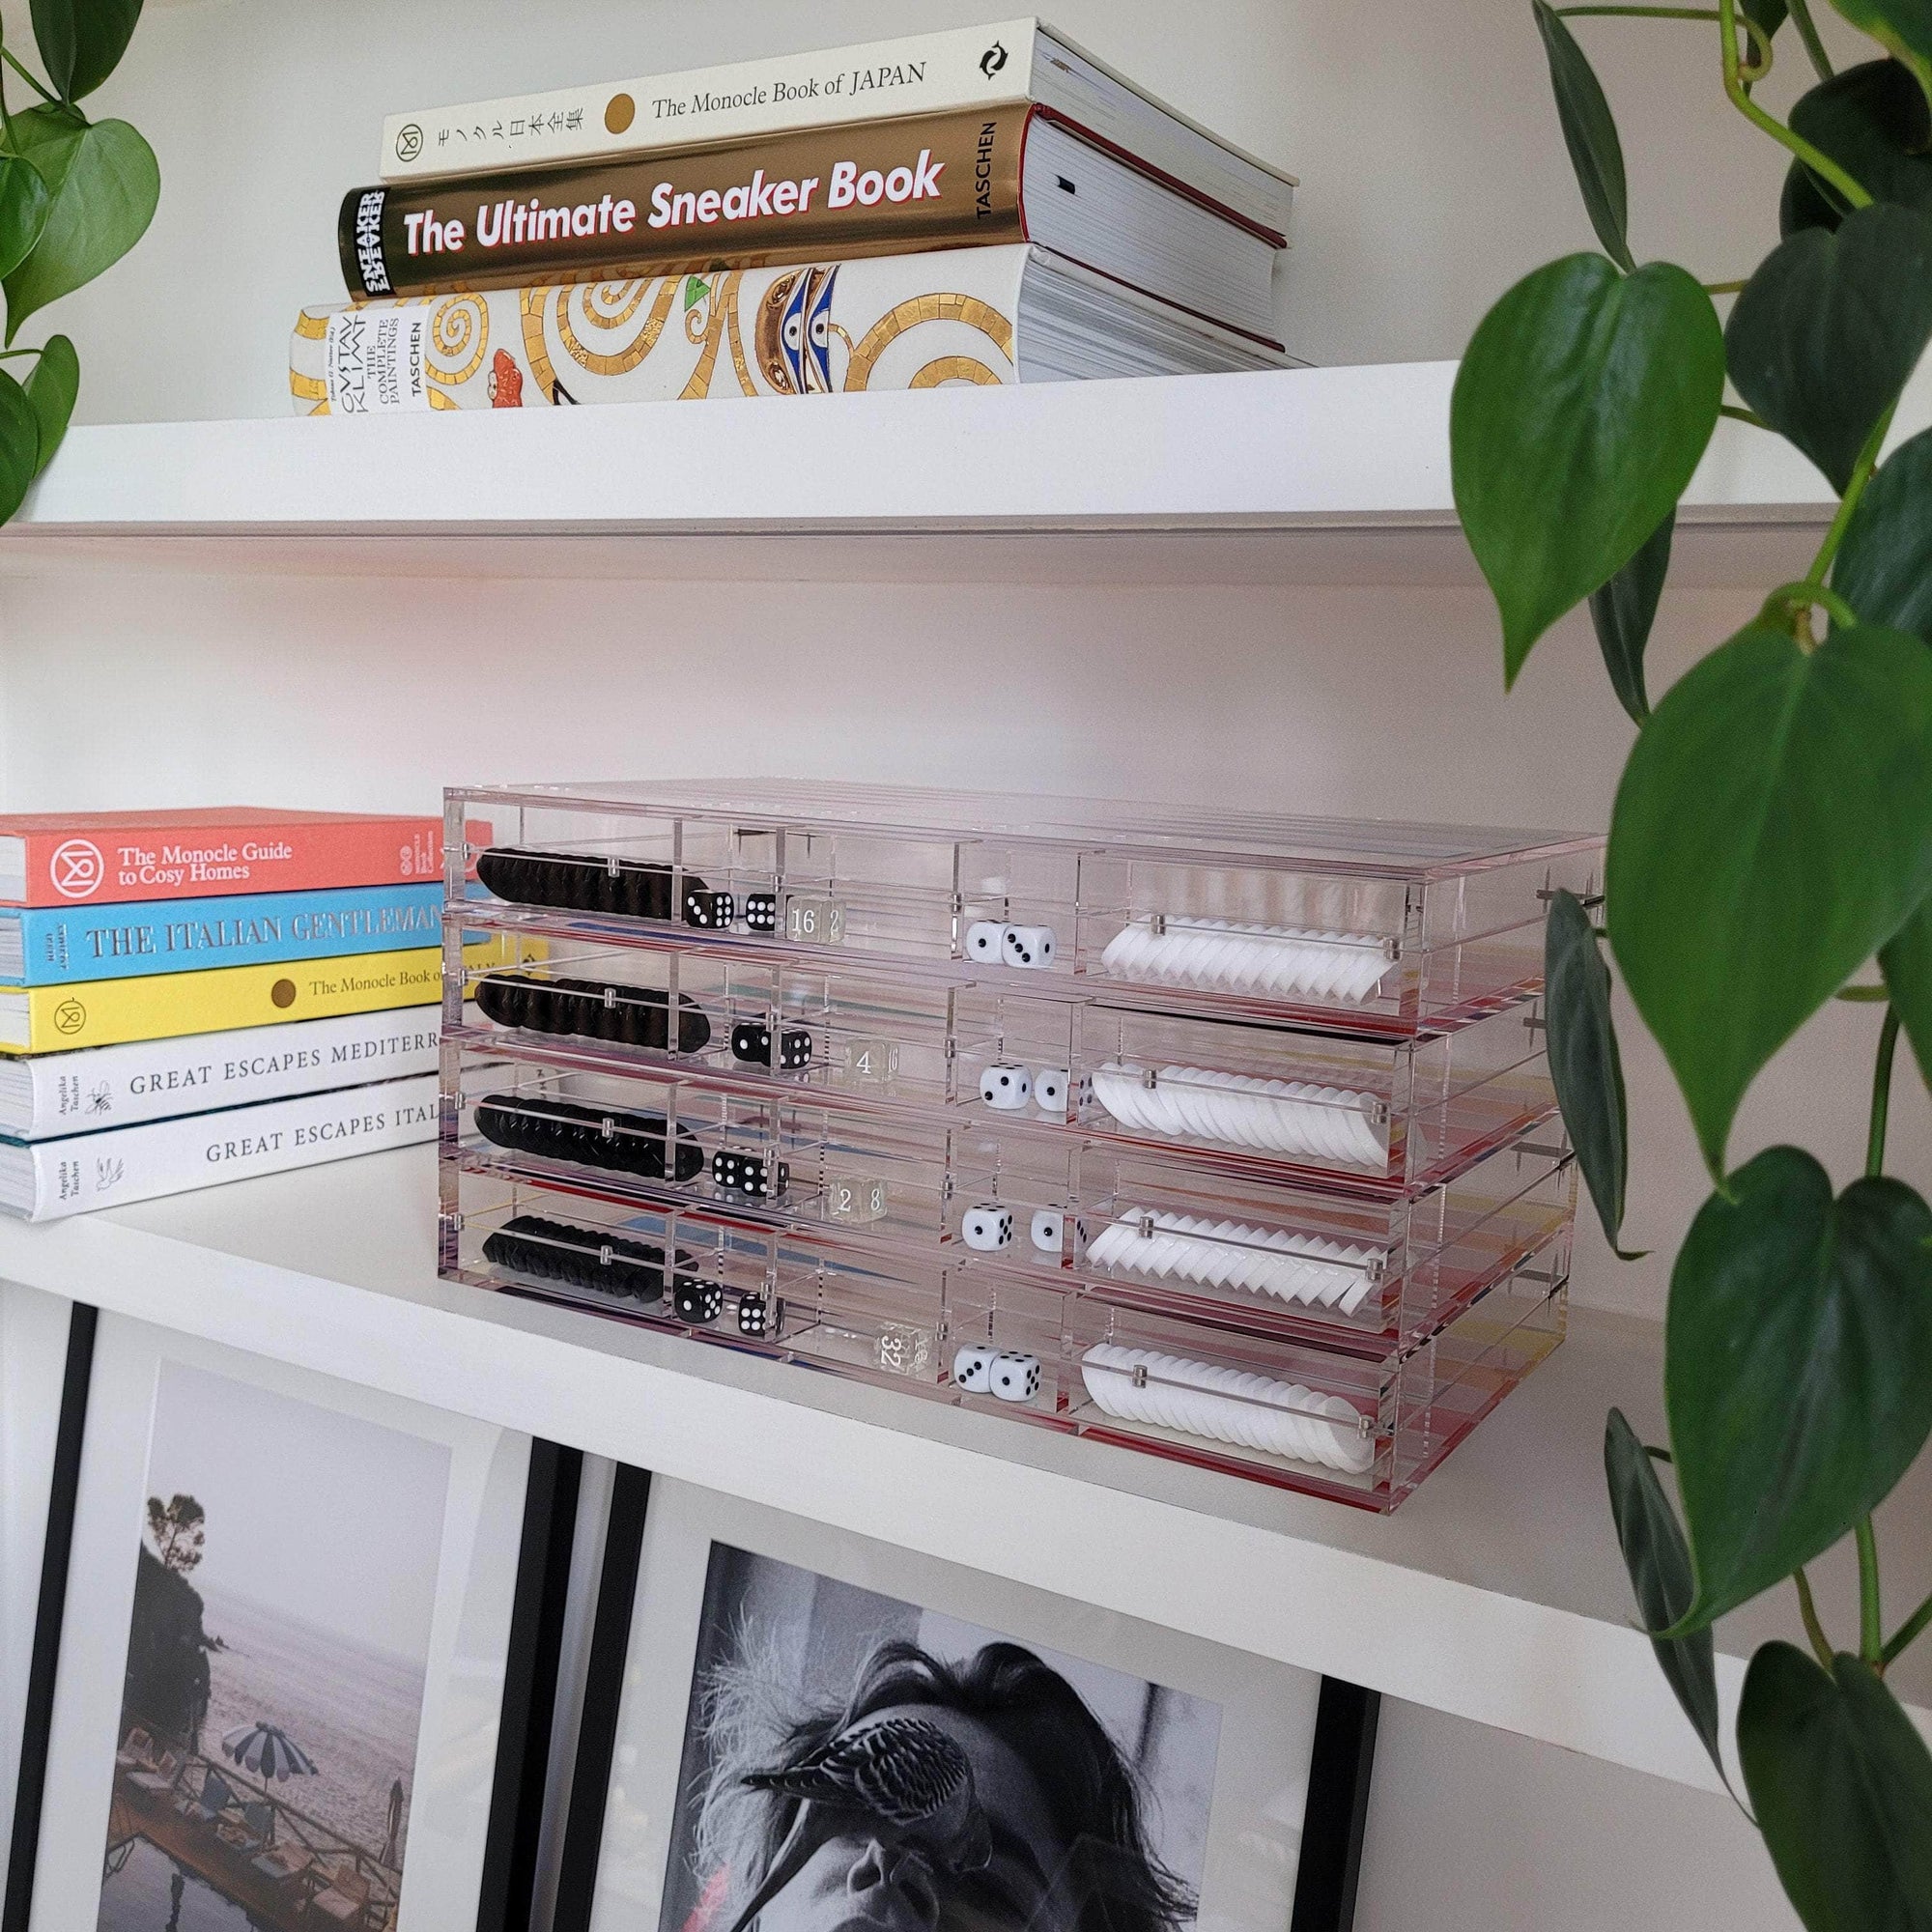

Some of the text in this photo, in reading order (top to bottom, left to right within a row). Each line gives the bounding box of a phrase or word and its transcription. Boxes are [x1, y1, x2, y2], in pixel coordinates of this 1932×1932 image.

[652, 61, 927, 119] The Monocle Book of JAPAN
[976, 122, 997, 219] TASCHEN
[403, 149, 947, 256] The Ultimate Sneaker Book
[356, 191, 378, 292] SNEAKER
[351, 315, 369, 412] KLIMT
[367, 345, 376, 379] THE
[377, 319, 389, 405] COMPLETE
[386, 318, 400, 404] PAINTINGS
[410, 323, 422, 397] TASCHEN
[117, 841, 293, 867] The Monocle Guide
[118, 863, 250, 887] to Cosy Homes
[86, 924, 156, 958] THE
[164, 916, 282, 952] ITALIAN
[792, 908, 814, 933] 16
[830, 909, 839, 933] 2
[309, 980, 337, 996] The
[340, 973, 395, 993] Monocle
[400, 969, 430, 985] Book
[129, 1065, 213, 1095] GREAT
[224, 1048, 322, 1081] ESCAPES
[856, 1050, 871, 1074] 4
[59, 1075, 70, 1116] Angelika
[71, 1075, 79, 1112] Taschen
[206, 1132, 283, 1163] GREAT
[295, 1114, 385, 1146] ESCAPES
[59, 1161, 70, 1200] Angelika
[71, 1160, 80, 1197] Taschen
[839, 1188, 852, 1212] 2
[870, 1188, 880, 1210] 8
[880, 1335, 901, 1368] 32
